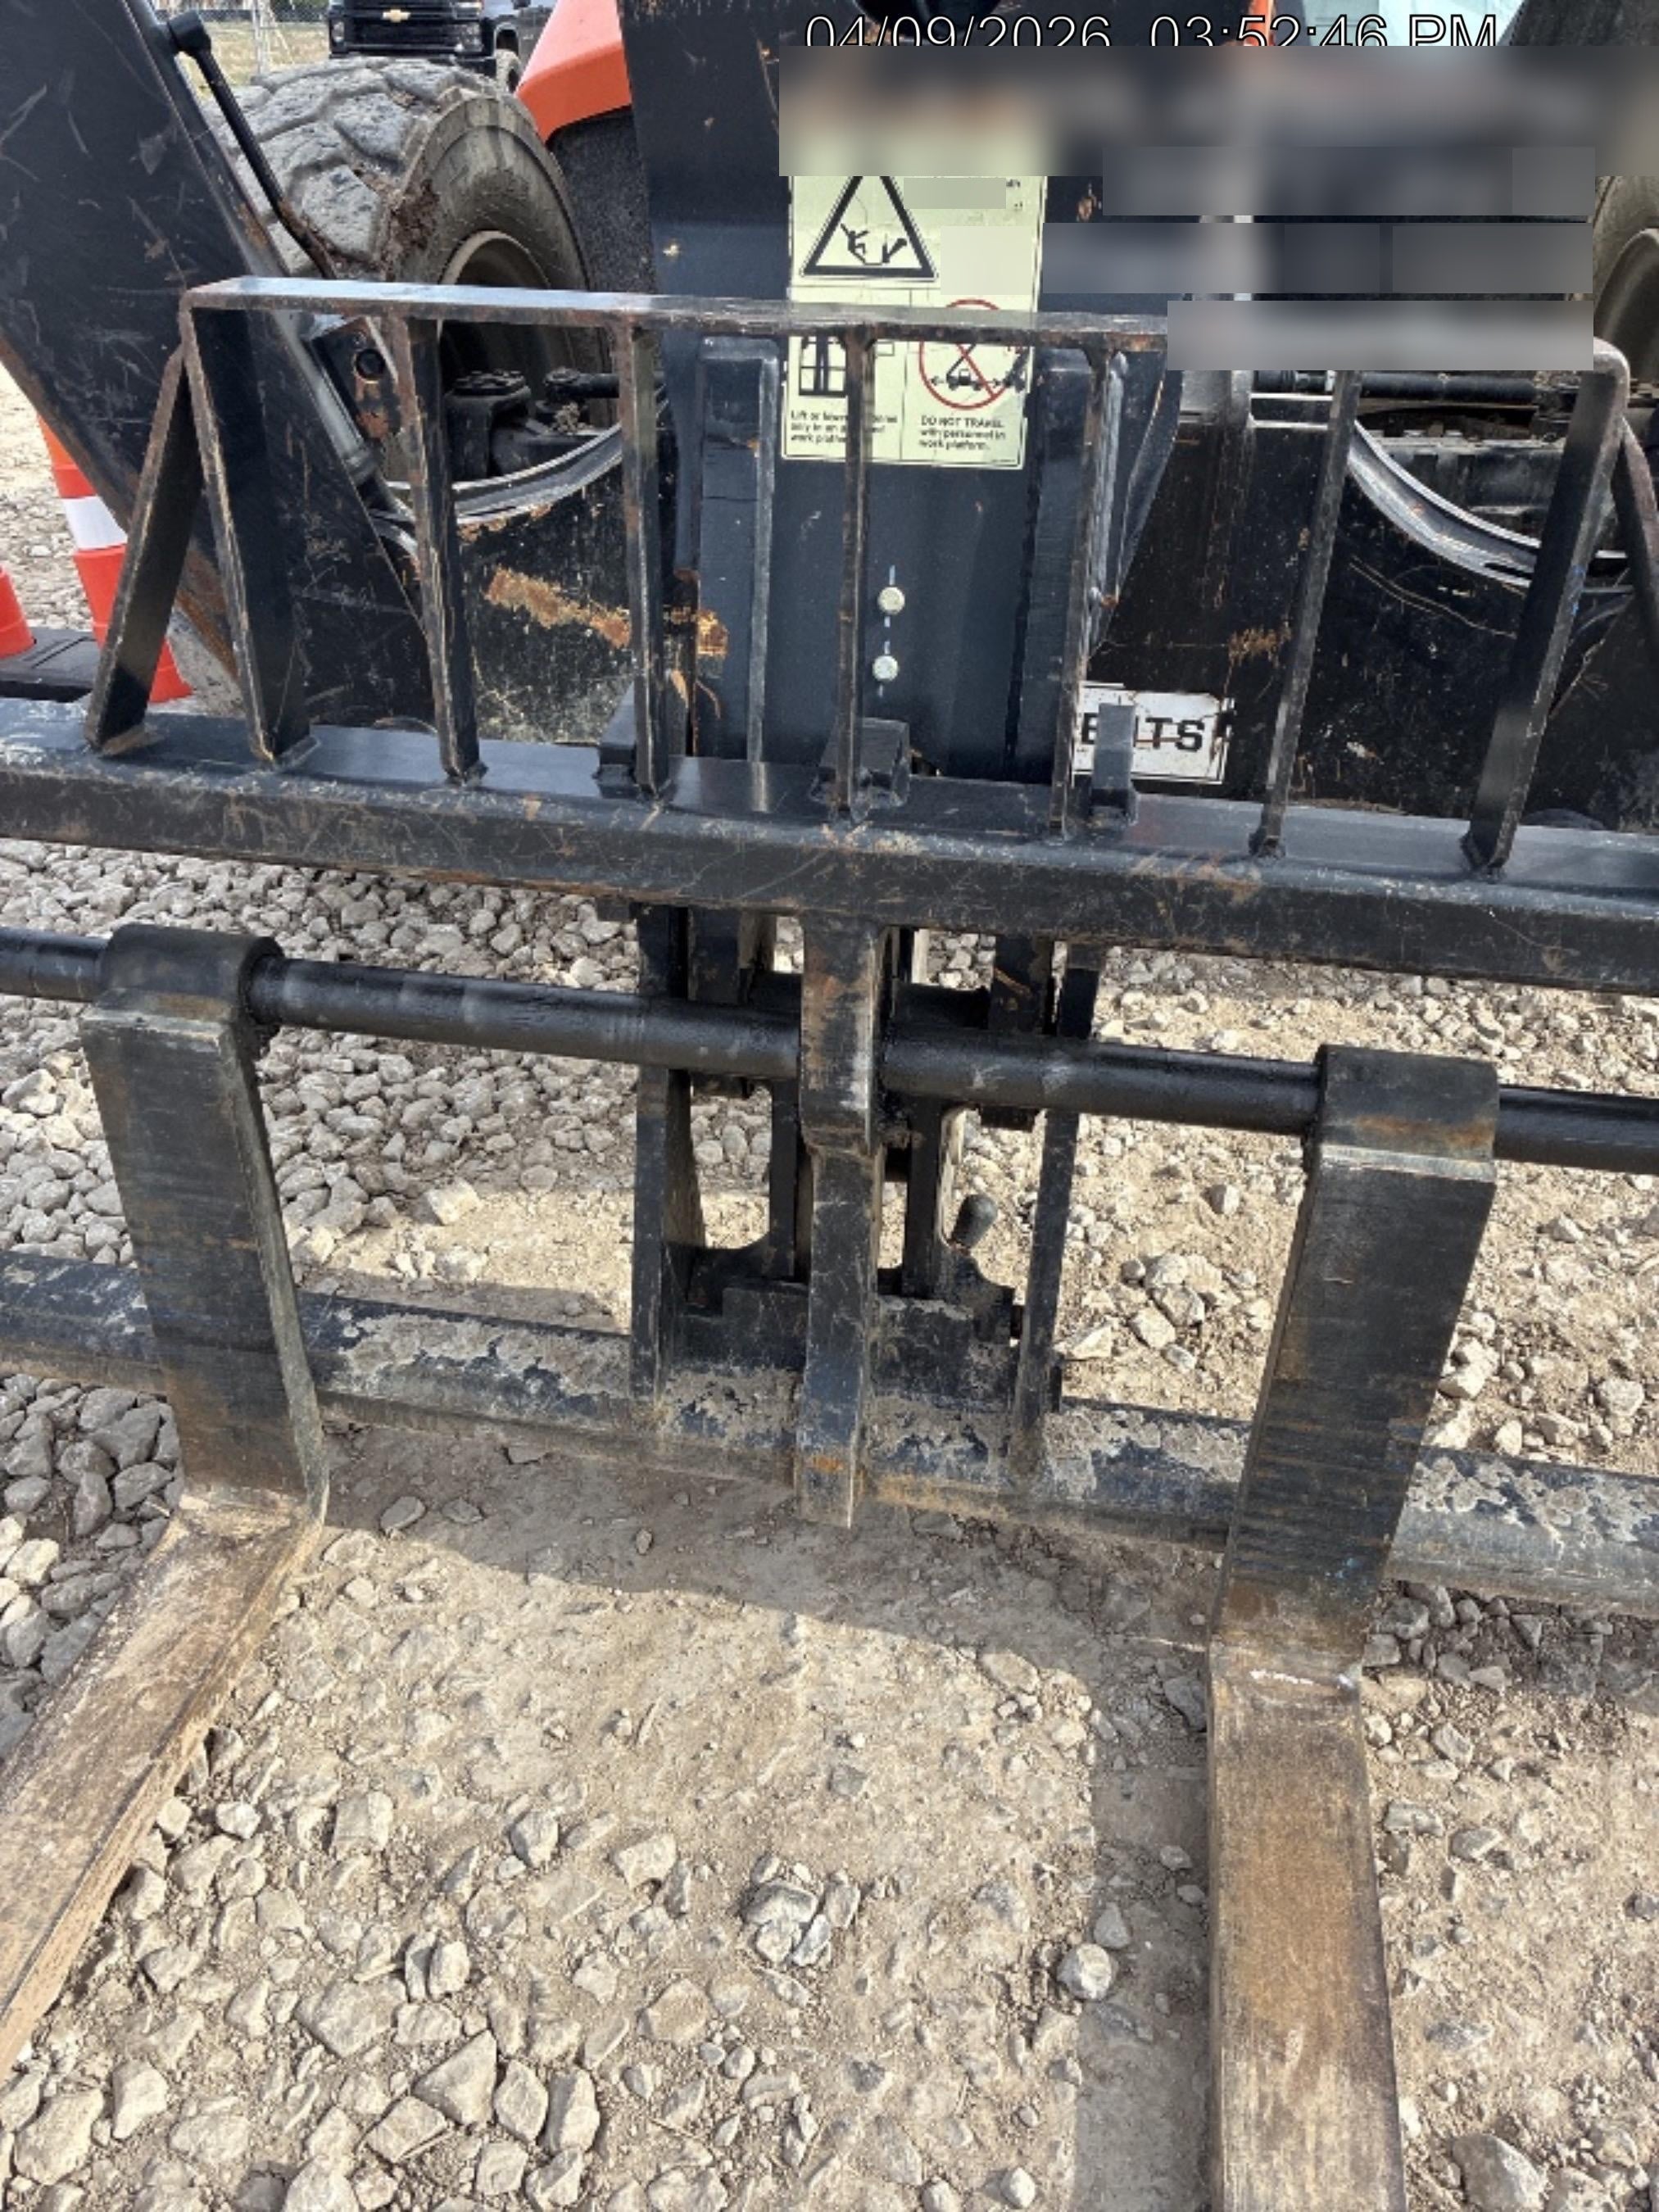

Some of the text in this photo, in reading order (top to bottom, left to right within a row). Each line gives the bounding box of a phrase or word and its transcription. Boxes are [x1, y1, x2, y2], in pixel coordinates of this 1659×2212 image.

[921, 415, 1005, 428] DO NOT TRAVEL
[1081, 712, 1205, 752] ETS
